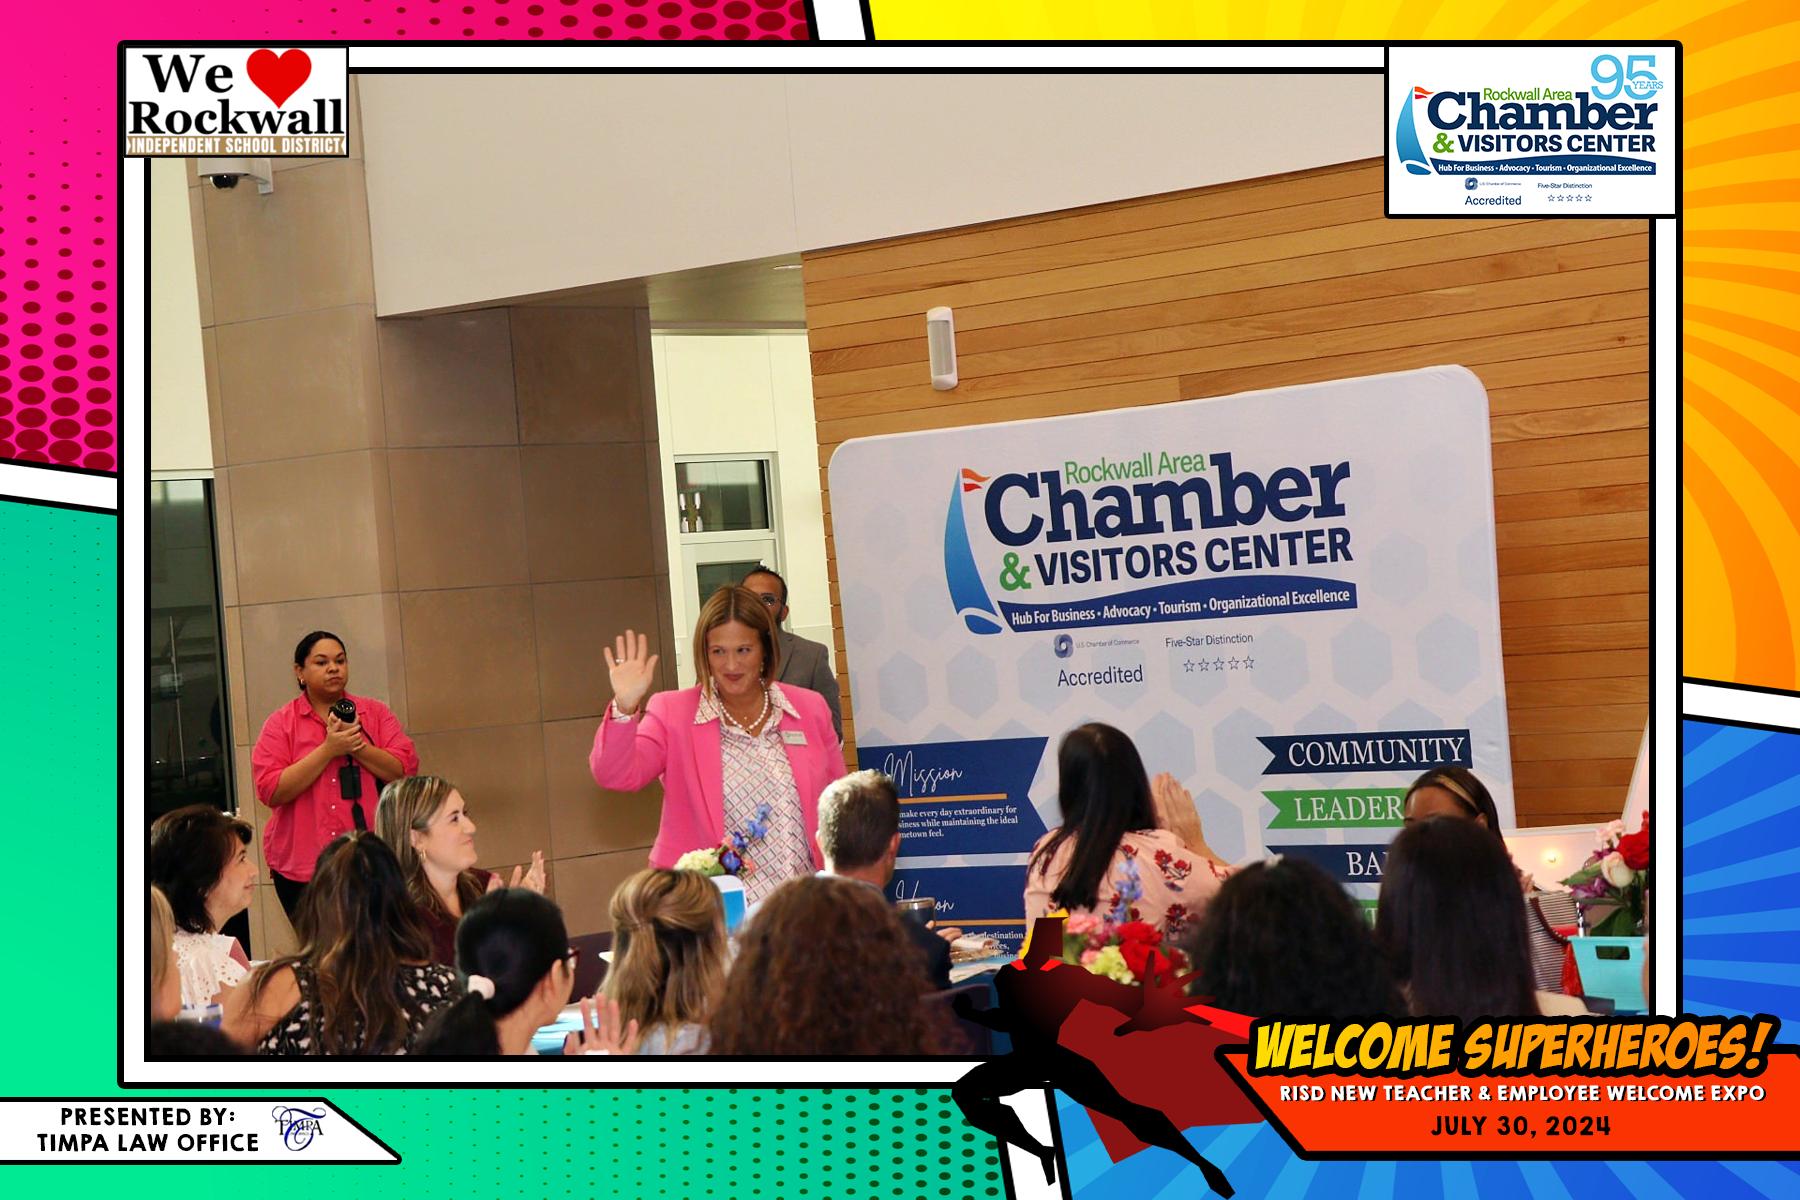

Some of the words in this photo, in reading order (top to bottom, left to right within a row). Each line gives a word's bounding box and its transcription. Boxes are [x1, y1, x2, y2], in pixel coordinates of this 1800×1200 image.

[1064, 452, 1153, 485] Rockwall
[1157, 451, 1207, 476] Area
[984, 452, 1351, 547] Chamber
[999, 551, 1032, 592] &
[1035, 541, 1198, 587] VISITORS
[1205, 527, 1354, 573] CENTER
[1012, 611, 1033, 626] Hub
[1034, 609, 1050, 624] For
[1051, 608, 1096, 622] Business
[1103, 604, 1151, 620] Advocacy
[1158, 600, 1201, 615] Tourism
[1209, 592, 1290, 614] Organizational
[1292, 588, 1350, 605] Excellence
[1165, 636, 1204, 648] Five-Star
[1206, 634, 1254, 645] Distinction
[1057, 665, 1143, 687] Accredited
[1288, 737, 1465, 767] COMMUNITY
[884, 750, 963, 797] Mission
[898, 820, 920, 829] siness
[920, 819, 940, 828] while
[941, 817, 986, 827] maintaining
[986, 816, 999, 825] the
[999, 815, 1018, 824] ideal
[899, 809, 918, 818] make
[919, 810, 939, 819] every
[939, 808, 952, 818] day
[954, 805, 1004, 816] extraordinary
[1005, 805, 1017, 814] for
[1294, 794, 1406, 822] LEADER
[899, 831, 928, 839] metown
[928, 829, 945, 837] feel.
